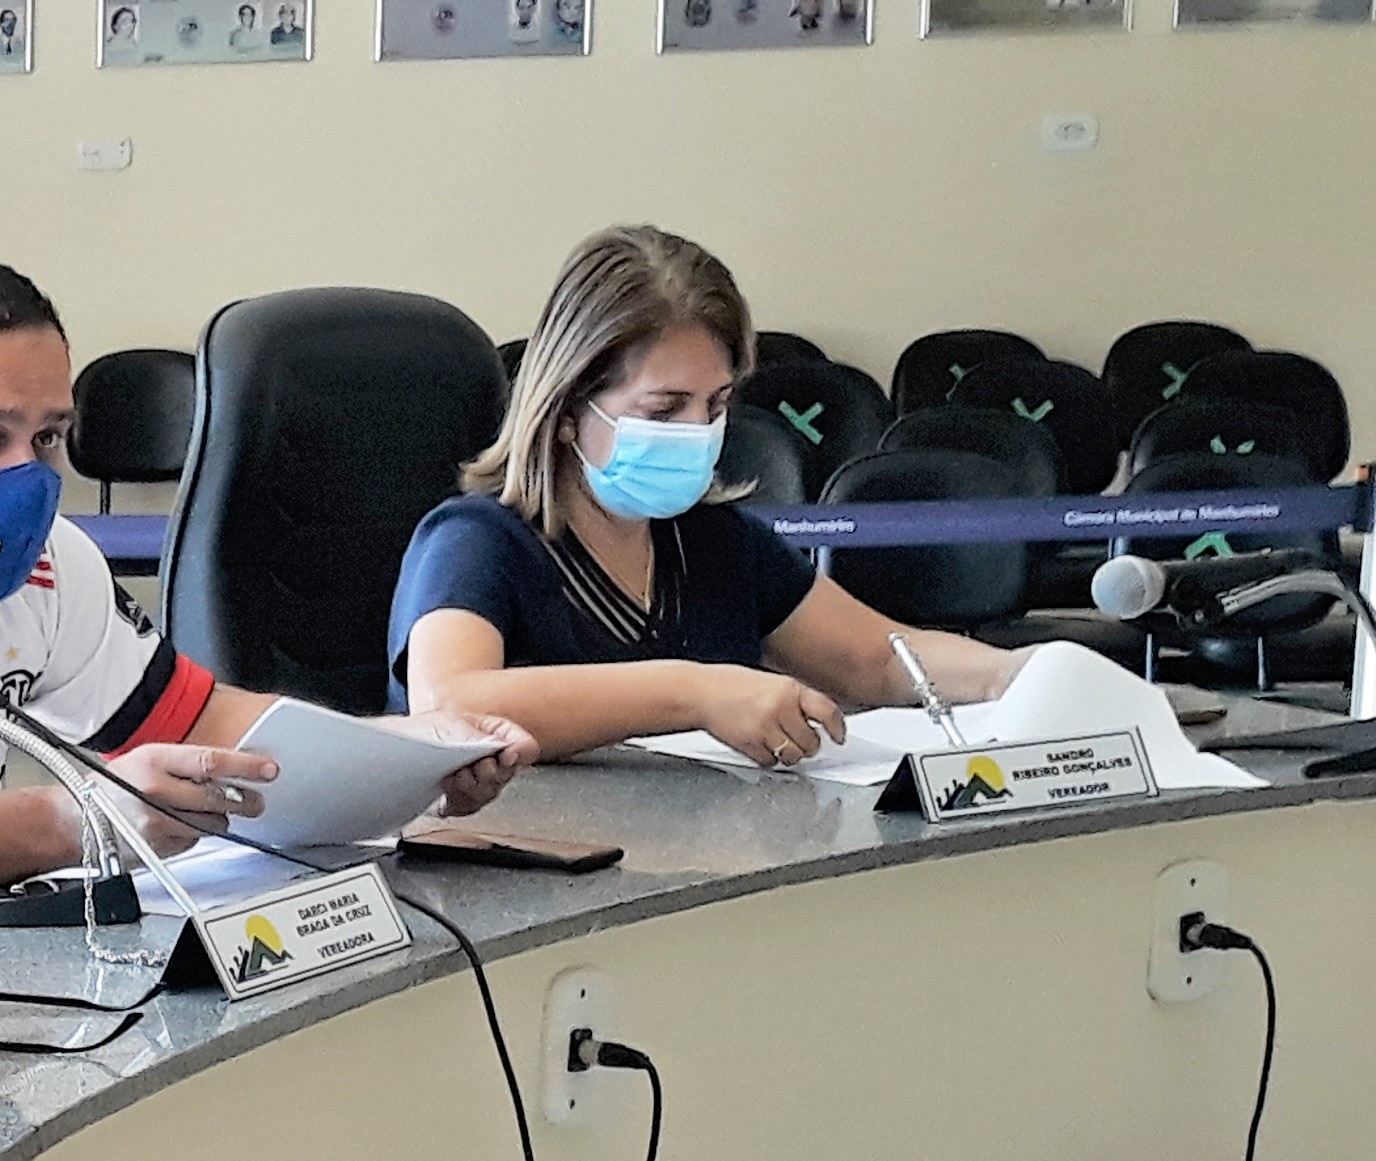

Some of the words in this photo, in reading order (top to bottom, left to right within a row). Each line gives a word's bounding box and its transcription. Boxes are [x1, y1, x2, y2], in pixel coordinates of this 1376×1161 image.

[1047, 748, 1094, 762] SANDRO
[1012, 766, 1059, 780] RIBEIRO
[1063, 757, 1132, 775] GONÇALVES
[1048, 783, 1109, 799] VEREADOR
[329, 893, 359, 909] MARIA
[297, 919, 329, 936] BRAGA
[331, 914, 344, 926] DA
[346, 904, 371, 921] CRUZ
[317, 932, 374, 958] VEREADORA
